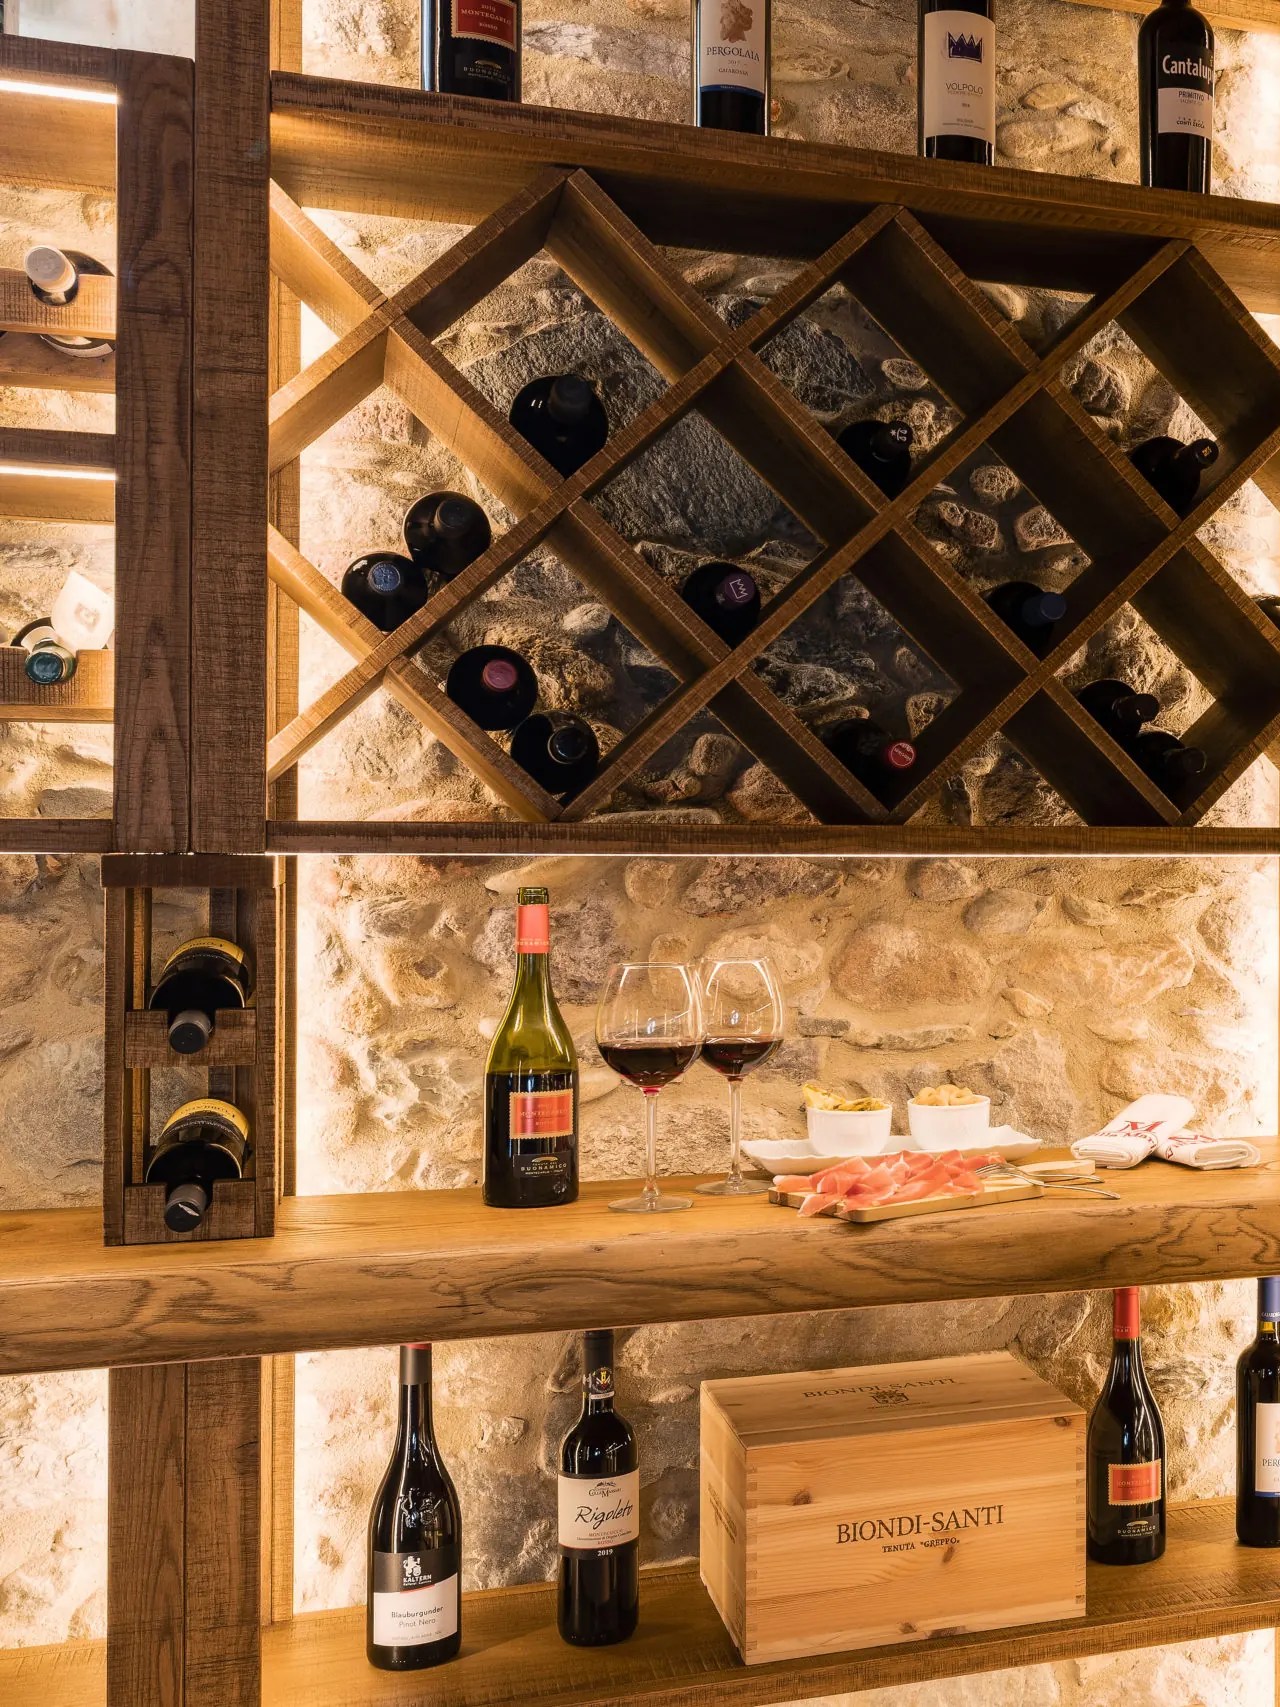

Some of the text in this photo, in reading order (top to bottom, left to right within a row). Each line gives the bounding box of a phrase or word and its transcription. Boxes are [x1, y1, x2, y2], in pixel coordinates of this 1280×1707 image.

[706, 46, 760, 61] PERGOLAIA
[945, 82, 984, 95] VOLPOLO
[520, 1163, 567, 1171] BUONAMICO
[803, 1378, 956, 1398] BIONDI-SANTI
[575, 1499, 633, 1530] Rigoleto
[836, 1504, 1003, 1544] BIONDI-SANTI
[597, 1549, 613, 1557] 2019
[882, 1543, 915, 1553] TENUTA
[403, 1574, 432, 1583] KALTERN
[391, 1606, 444, 1618] Blauburgunder
[399, 1618, 436, 1628] Pinot Nero
